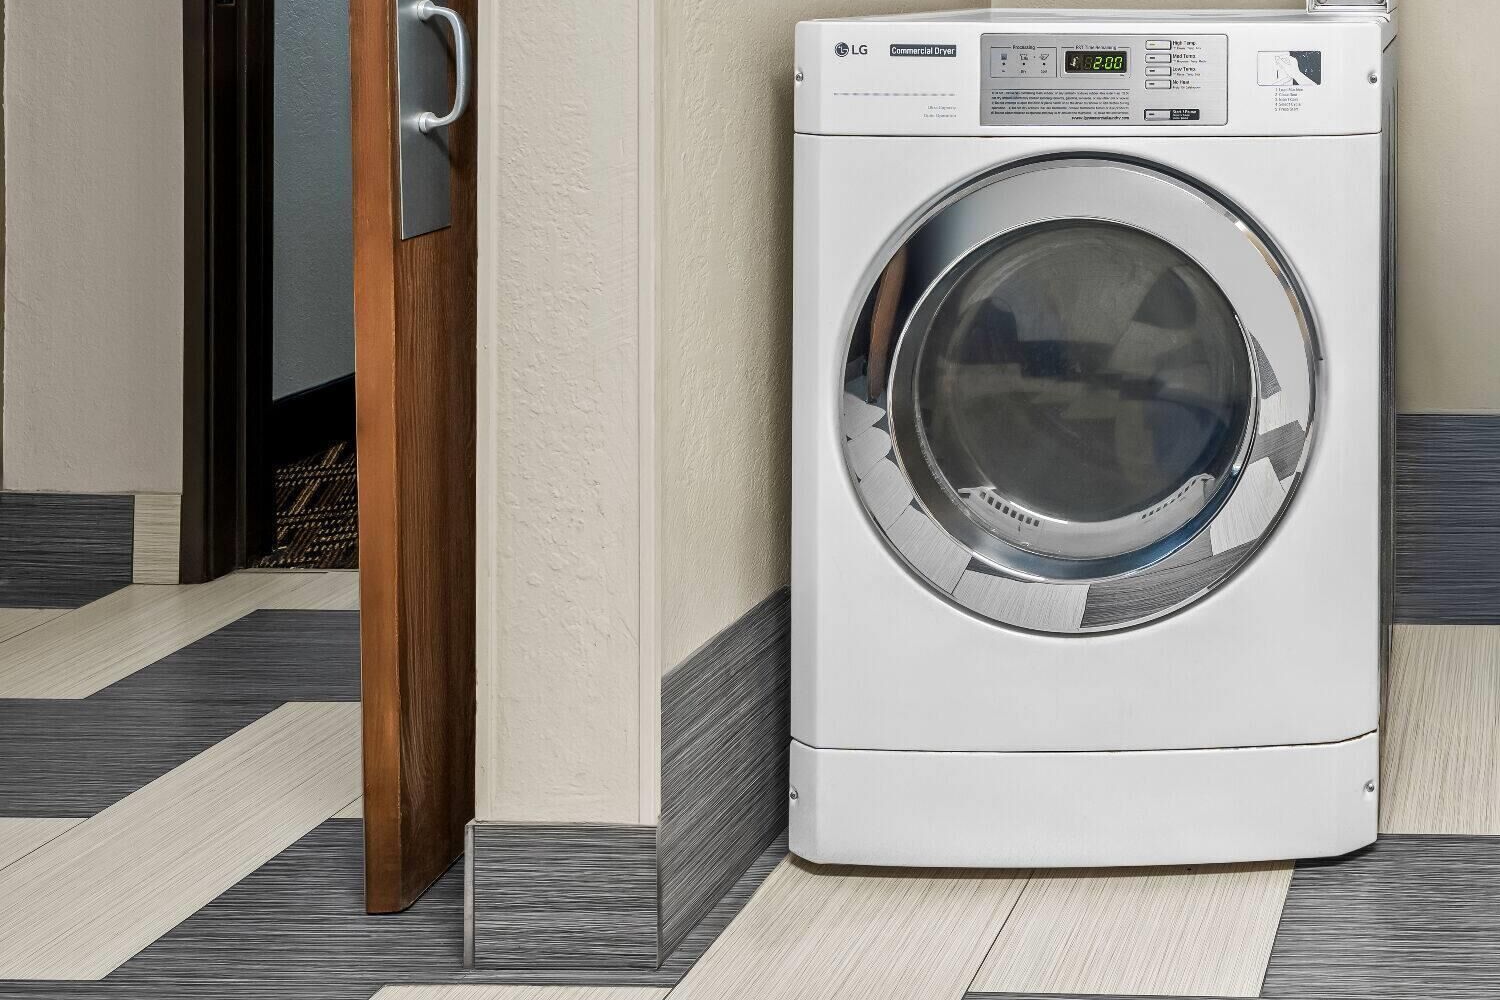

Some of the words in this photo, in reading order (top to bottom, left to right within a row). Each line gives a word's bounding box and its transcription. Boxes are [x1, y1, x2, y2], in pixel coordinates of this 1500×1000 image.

[851, 44, 868, 55] LG
[891, 46, 933, 55] Commercial
[934, 46, 955, 56] Dryer
